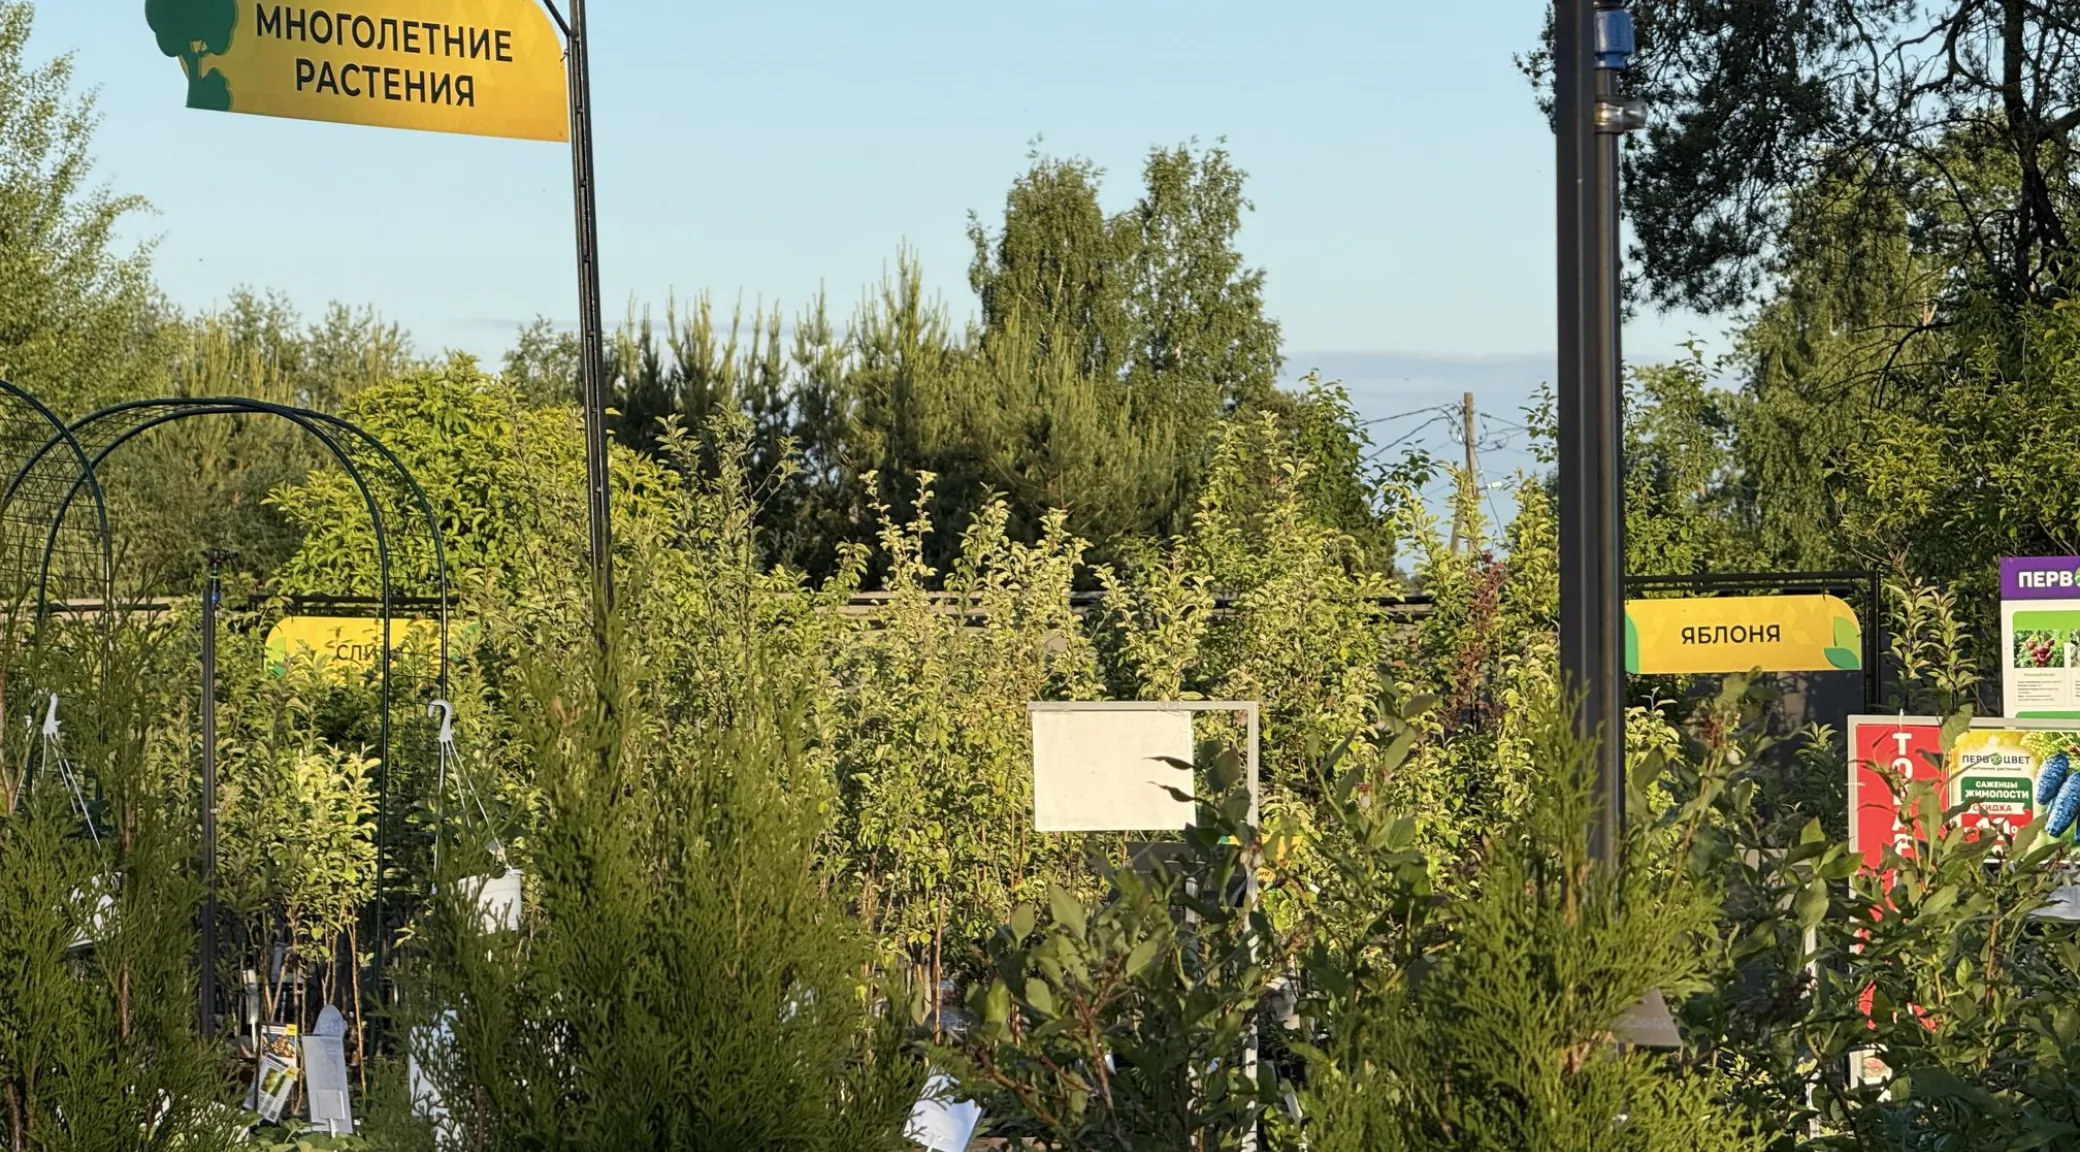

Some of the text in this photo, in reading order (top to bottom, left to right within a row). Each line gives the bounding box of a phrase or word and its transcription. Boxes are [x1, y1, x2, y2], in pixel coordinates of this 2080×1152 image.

[256, 3, 513, 63] МНОГОЛЕТНИЕ
[296, 58, 475, 108] РАСТЕНИЯ
[1681, 624, 1781, 645] ЯБЛОНЯ
[1964, 790, 2030, 799] ЖИМОЛОСТИ
[1975, 780, 2018, 789] САЖЕНЦЫ
